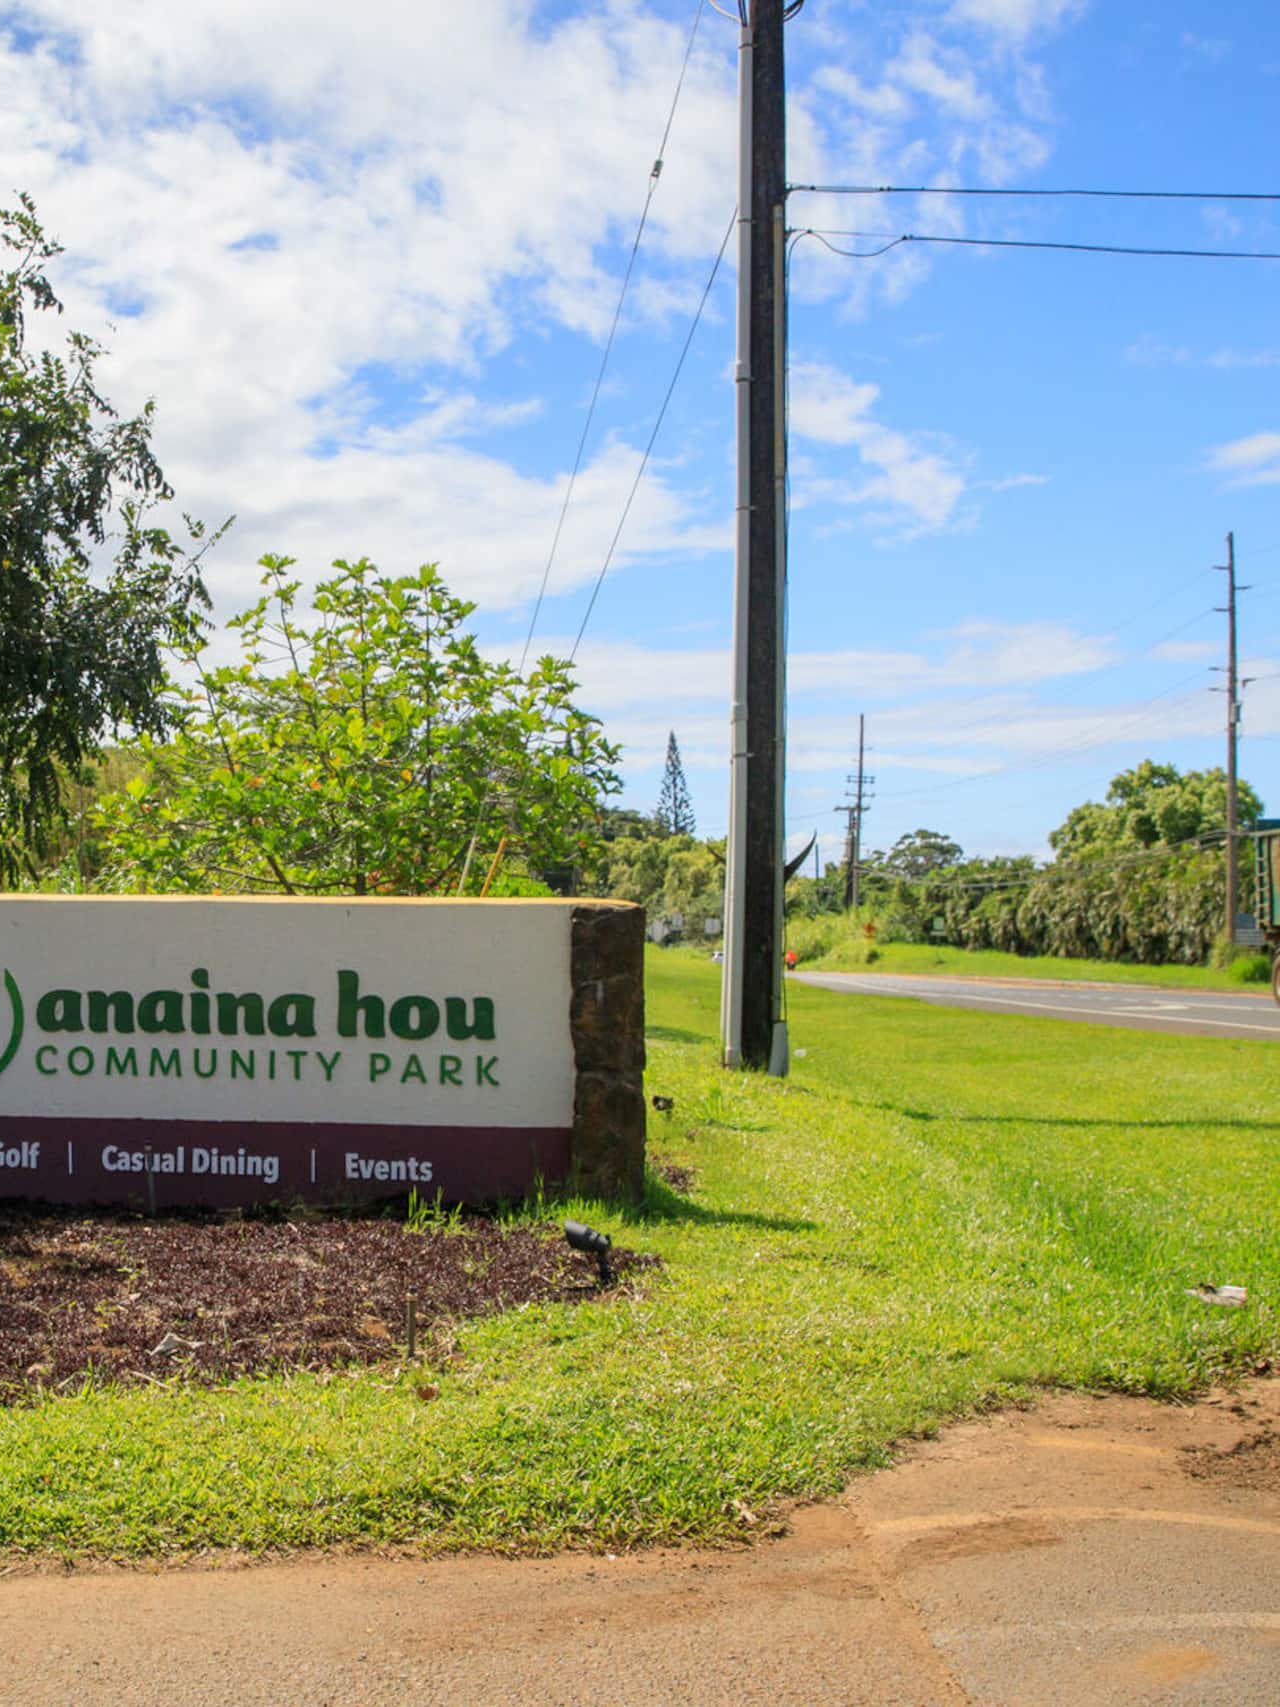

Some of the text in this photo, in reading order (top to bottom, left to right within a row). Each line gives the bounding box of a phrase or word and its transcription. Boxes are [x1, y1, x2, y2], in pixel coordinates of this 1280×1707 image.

[36, 968, 496, 1041] anaina hou
[35, 1044, 501, 1087] COMMUNITY PARK
[101, 1145, 185, 1173] Casual
[191, 1148, 280, 1184] Dining
[344, 1152, 434, 1182] Events
